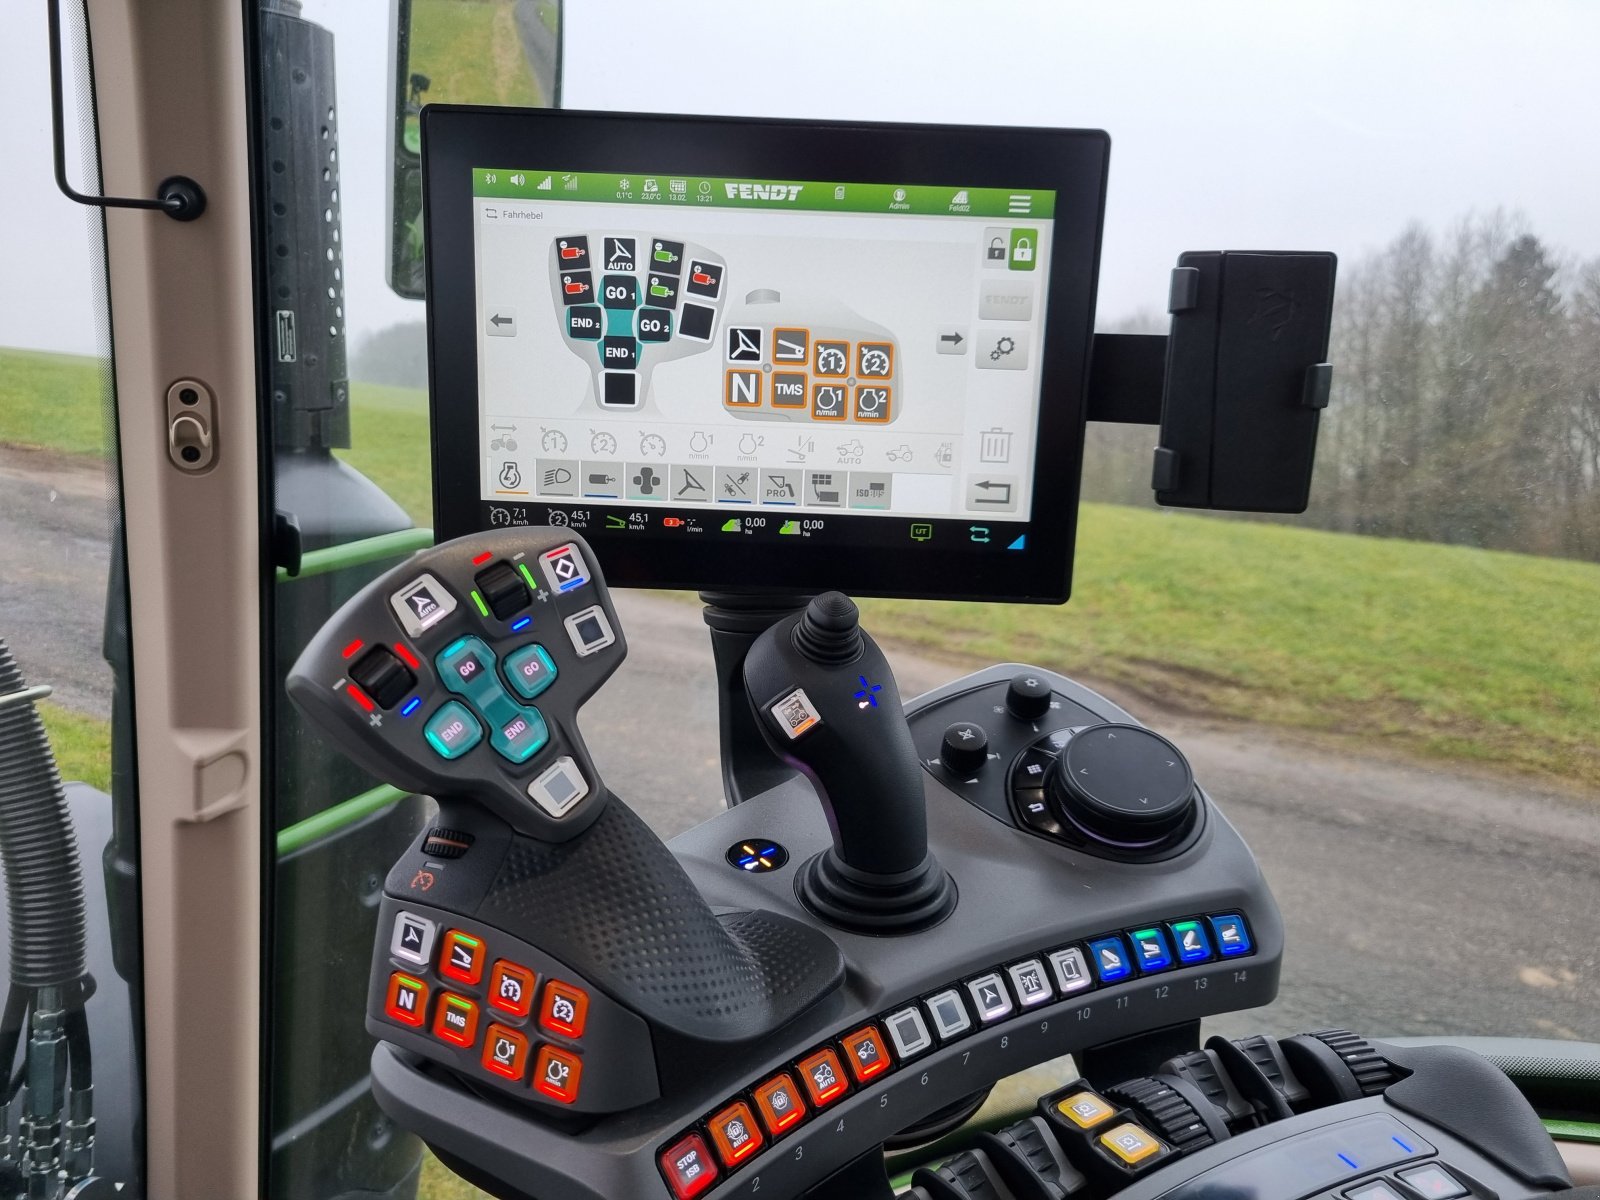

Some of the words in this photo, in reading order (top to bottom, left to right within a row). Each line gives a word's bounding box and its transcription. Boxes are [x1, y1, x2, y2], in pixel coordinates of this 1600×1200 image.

[724, 183, 804, 201] FENDT
[889, 202, 910, 210] Admin
[502, 210, 543, 220] Fahrhebel
[608, 262, 633, 270] AUTO
[606, 286, 626, 300] GO
[571, 318, 592, 328] END
[640, 320, 660, 332] GO
[606, 347, 628, 358] END
[828, 357, 836, 369] 1
[870, 358, 881, 371] 2
[732, 373, 756, 403] N
[775, 383, 803, 396] TMS
[835, 390, 843, 401] 1
[878, 391, 887, 402] 2
[600, 439, 608, 450] 2
[708, 434, 714, 445] 1
[758, 436, 765, 447] 2
[836, 457, 862, 465] AUTO
[766, 489, 786, 498] PRO
[513, 508, 526, 518] 7,1
[570, 510, 590, 520] 45,1
[628, 513, 648, 523] 45,1
[555, 516, 562, 524] 2
[745, 518, 766, 528] 0,00
[803, 520, 824, 530] 0,00
[460, 661, 476, 676] GO
[524, 661, 540, 676] GO
[441, 721, 464, 742] END
[504, 720, 526, 740] END
[1232, 970, 1247, 984] 14
[1193, 977, 1208, 991] 13
[508, 986, 514, 998] 1
[1154, 986, 1169, 1000] 12
[398, 988, 414, 1010] N
[1115, 996, 1129, 1009] 11
[559, 1005, 568, 1018] 2
[1076, 1007, 1091, 1021] 10
[446, 1011, 466, 1028] TMS
[1040, 1022, 1048, 1035] 9
[1001, 1036, 1009, 1049] 8
[962, 1052, 970, 1066] 7
[562, 1066, 570, 1078] 2
[819, 1076, 836, 1090] AUTO
[920, 1072, 929, 1086] 6
[880, 1094, 888, 1108] 5
[836, 1118, 845, 1133] 4
[733, 1134, 749, 1148] AUTO
[795, 1146, 804, 1160] 3
[676, 1150, 697, 1170] STOP
[686, 1164, 700, 1178] ISB
[752, 1176, 760, 1193] 2
